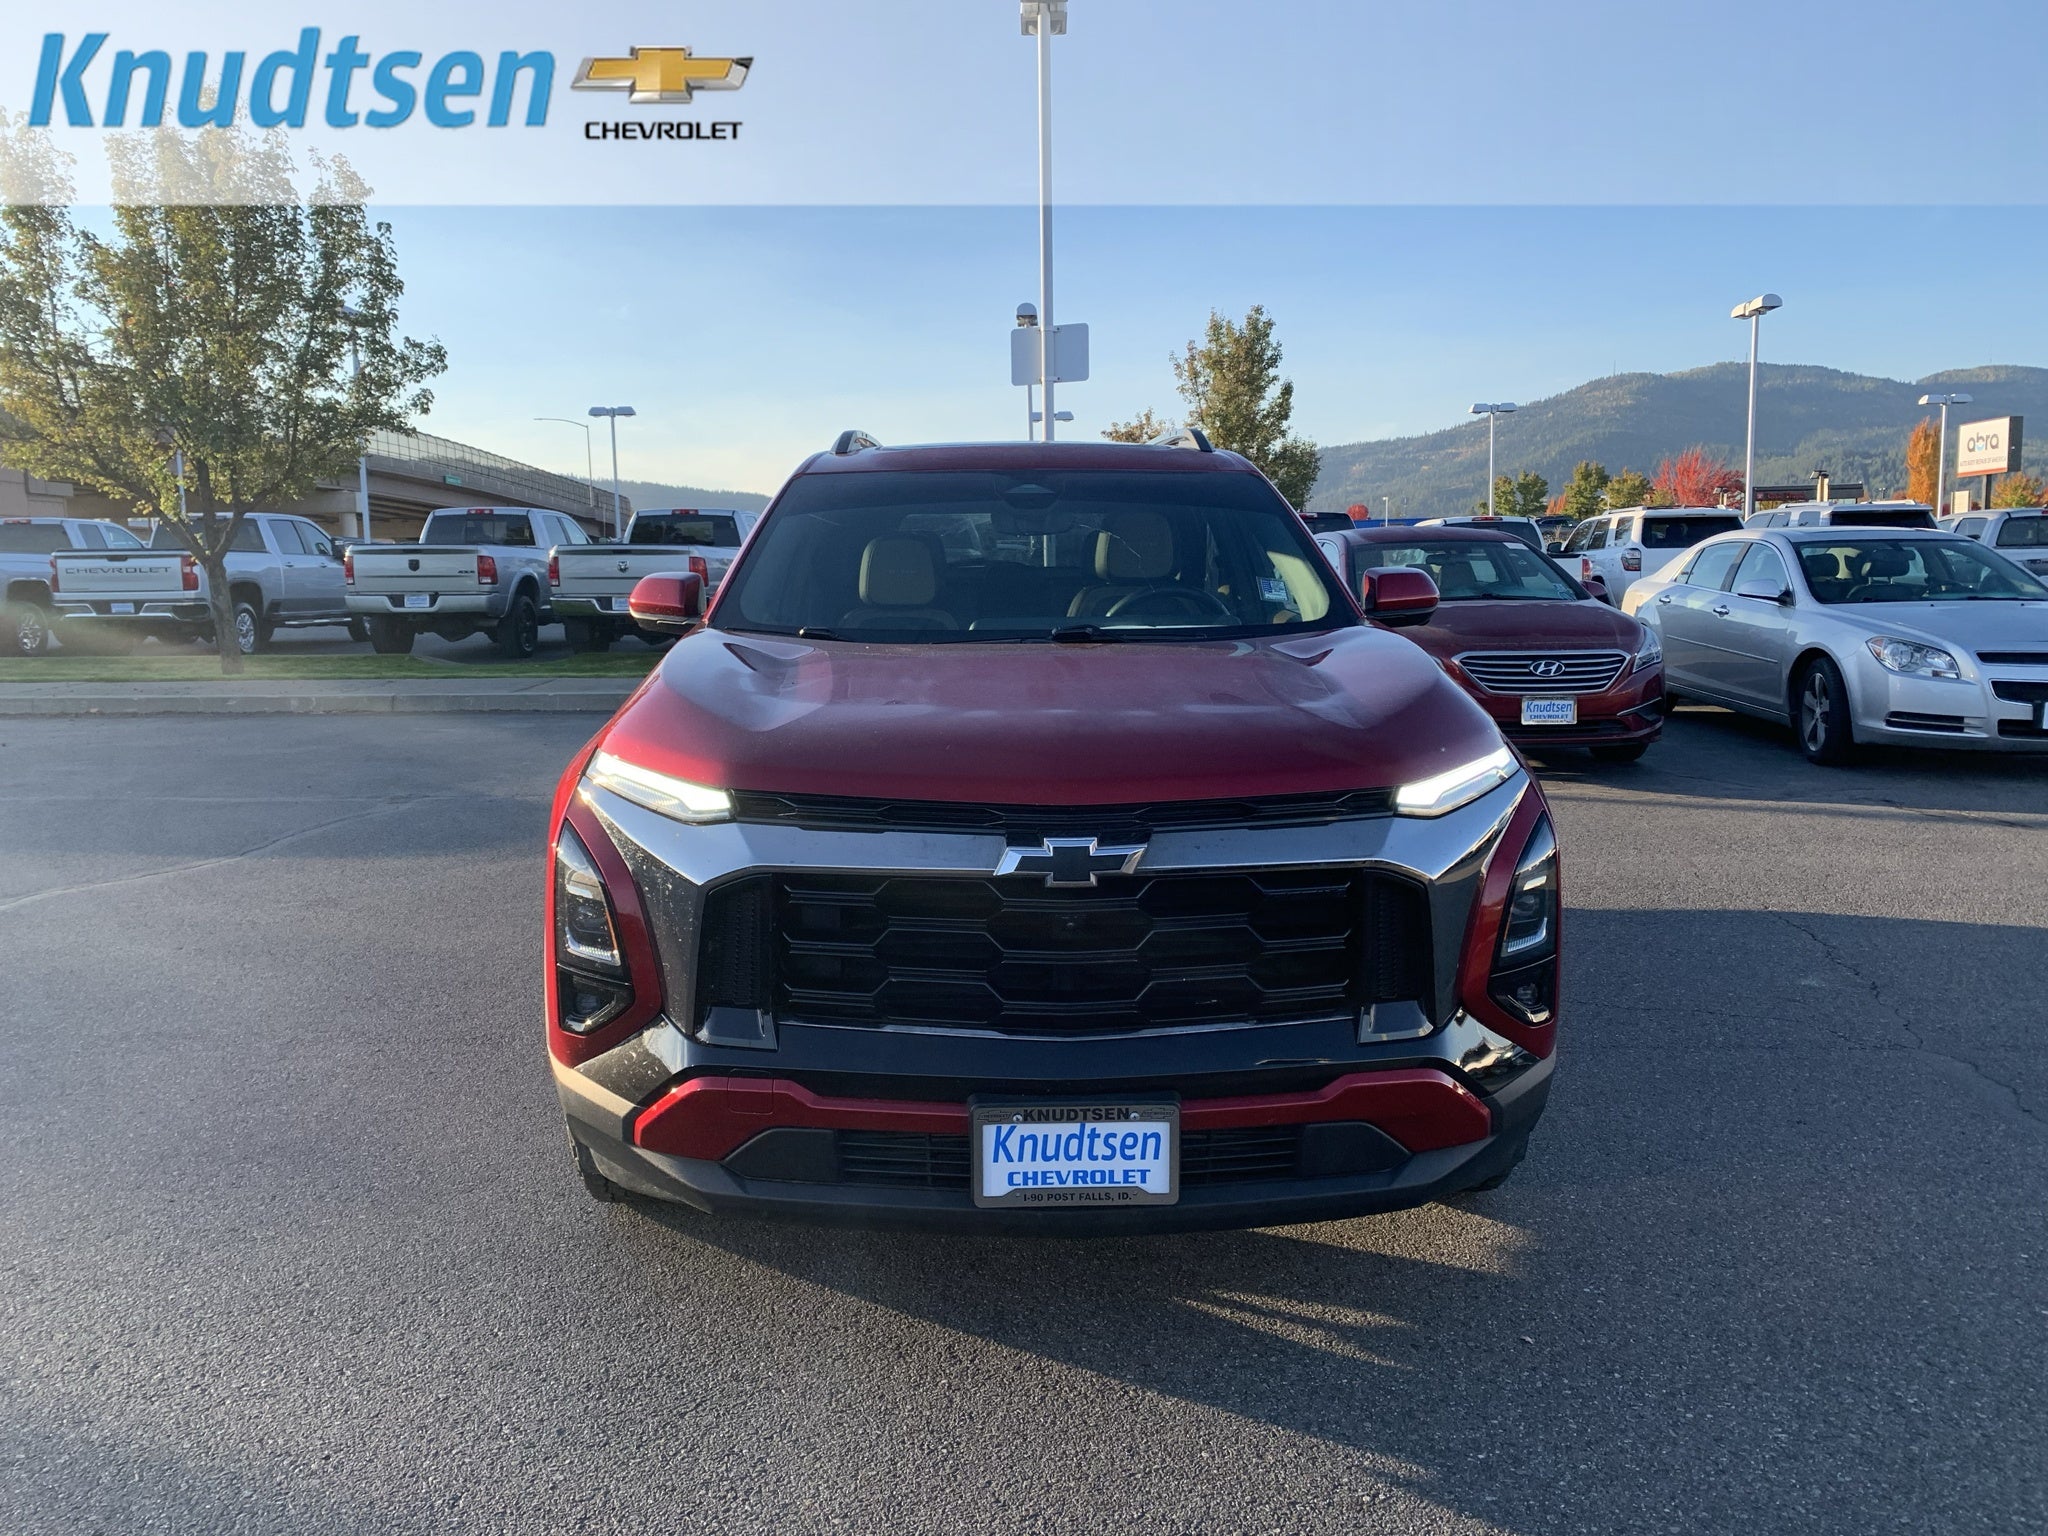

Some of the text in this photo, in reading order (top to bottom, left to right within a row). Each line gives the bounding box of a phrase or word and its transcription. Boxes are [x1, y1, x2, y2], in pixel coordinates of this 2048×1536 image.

[1967, 432, 1999, 452] abra
[65, 566, 172, 574] CHEVROLET
[1526, 701, 1573, 712] Knudtsen
[1023, 1107, 1130, 1121] KNUDTSEN
[993, 1123, 1162, 1163] Knudtsen
[1007, 1169, 1151, 1186] CHEVROLET
[1023, 1192, 1132, 1201] I-90 POST FALLS, ID.
